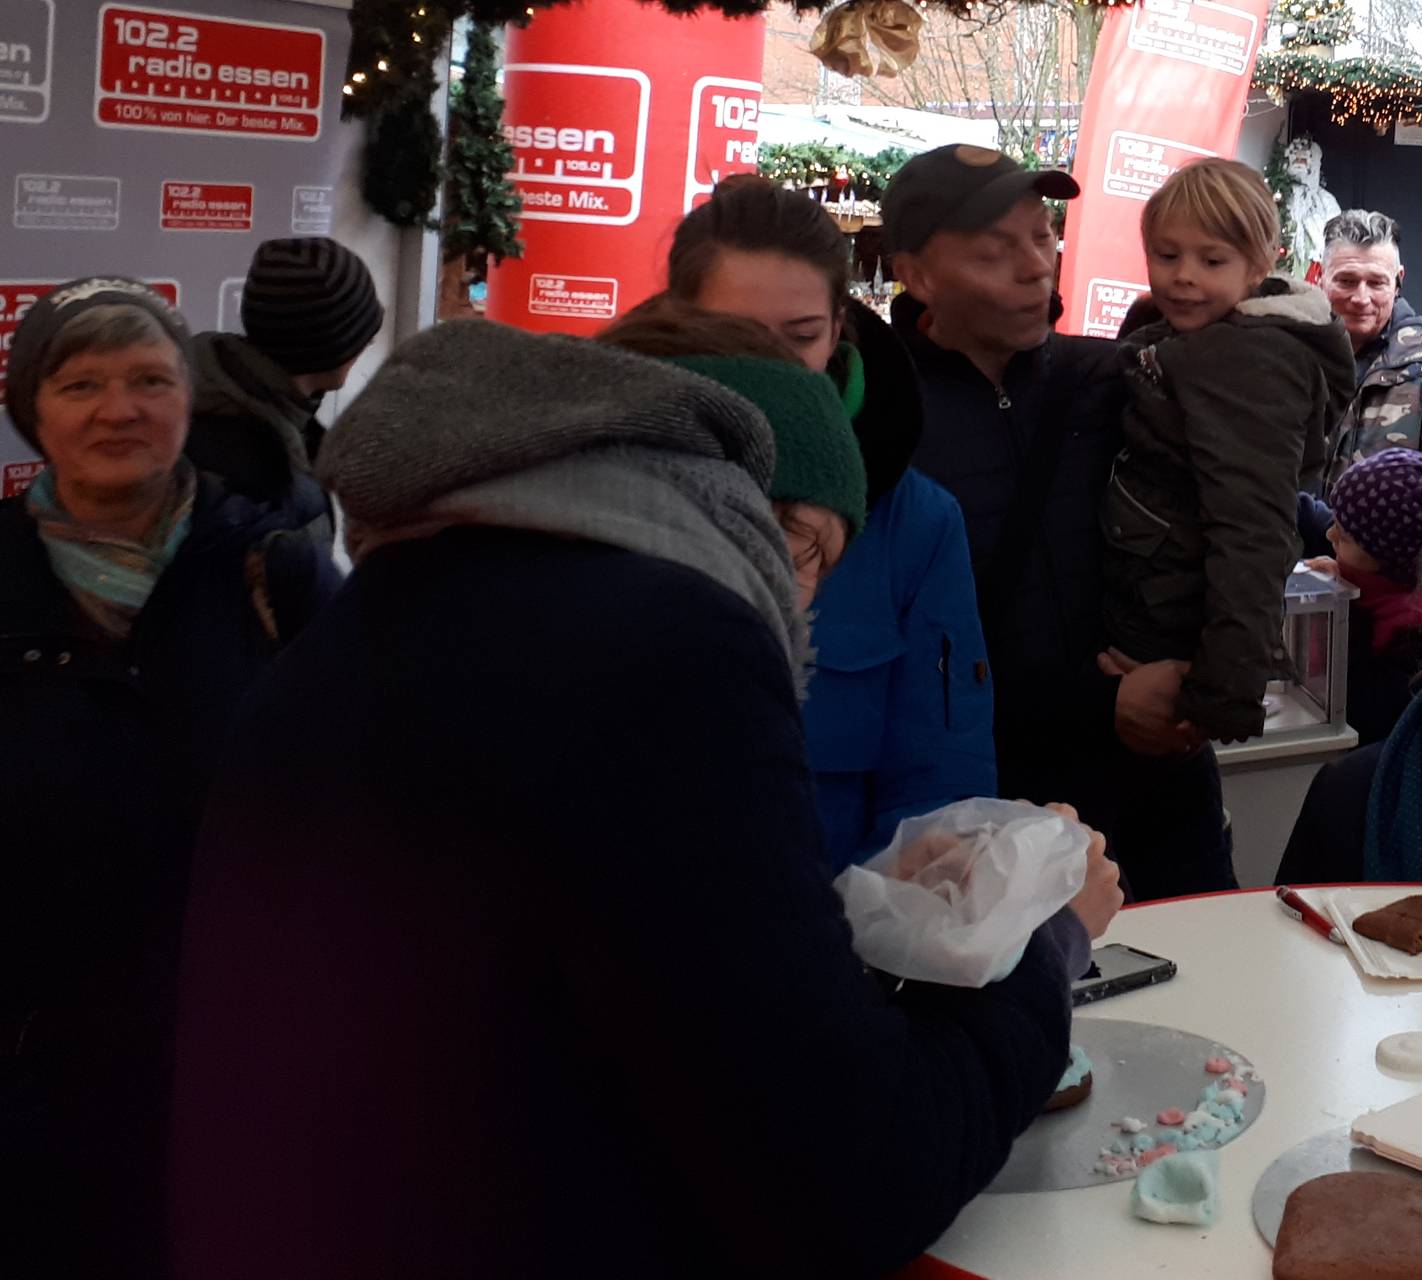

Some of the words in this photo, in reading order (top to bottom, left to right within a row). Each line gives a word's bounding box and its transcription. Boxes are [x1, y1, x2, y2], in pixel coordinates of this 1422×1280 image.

[114, 18, 199, 53] 102.2
[128, 53, 212, 81] radio
[218, 64, 309, 90] essen
[114, 104, 157, 121] 100%
[161, 111, 182, 123] von
[186, 110, 212, 125] hier.
[216, 112, 238, 126] Der
[242, 114, 277, 129] beste
[281, 117, 306, 131] Mix.
[712, 95, 759, 132] 102
[568, 190, 609, 210] Mix.
